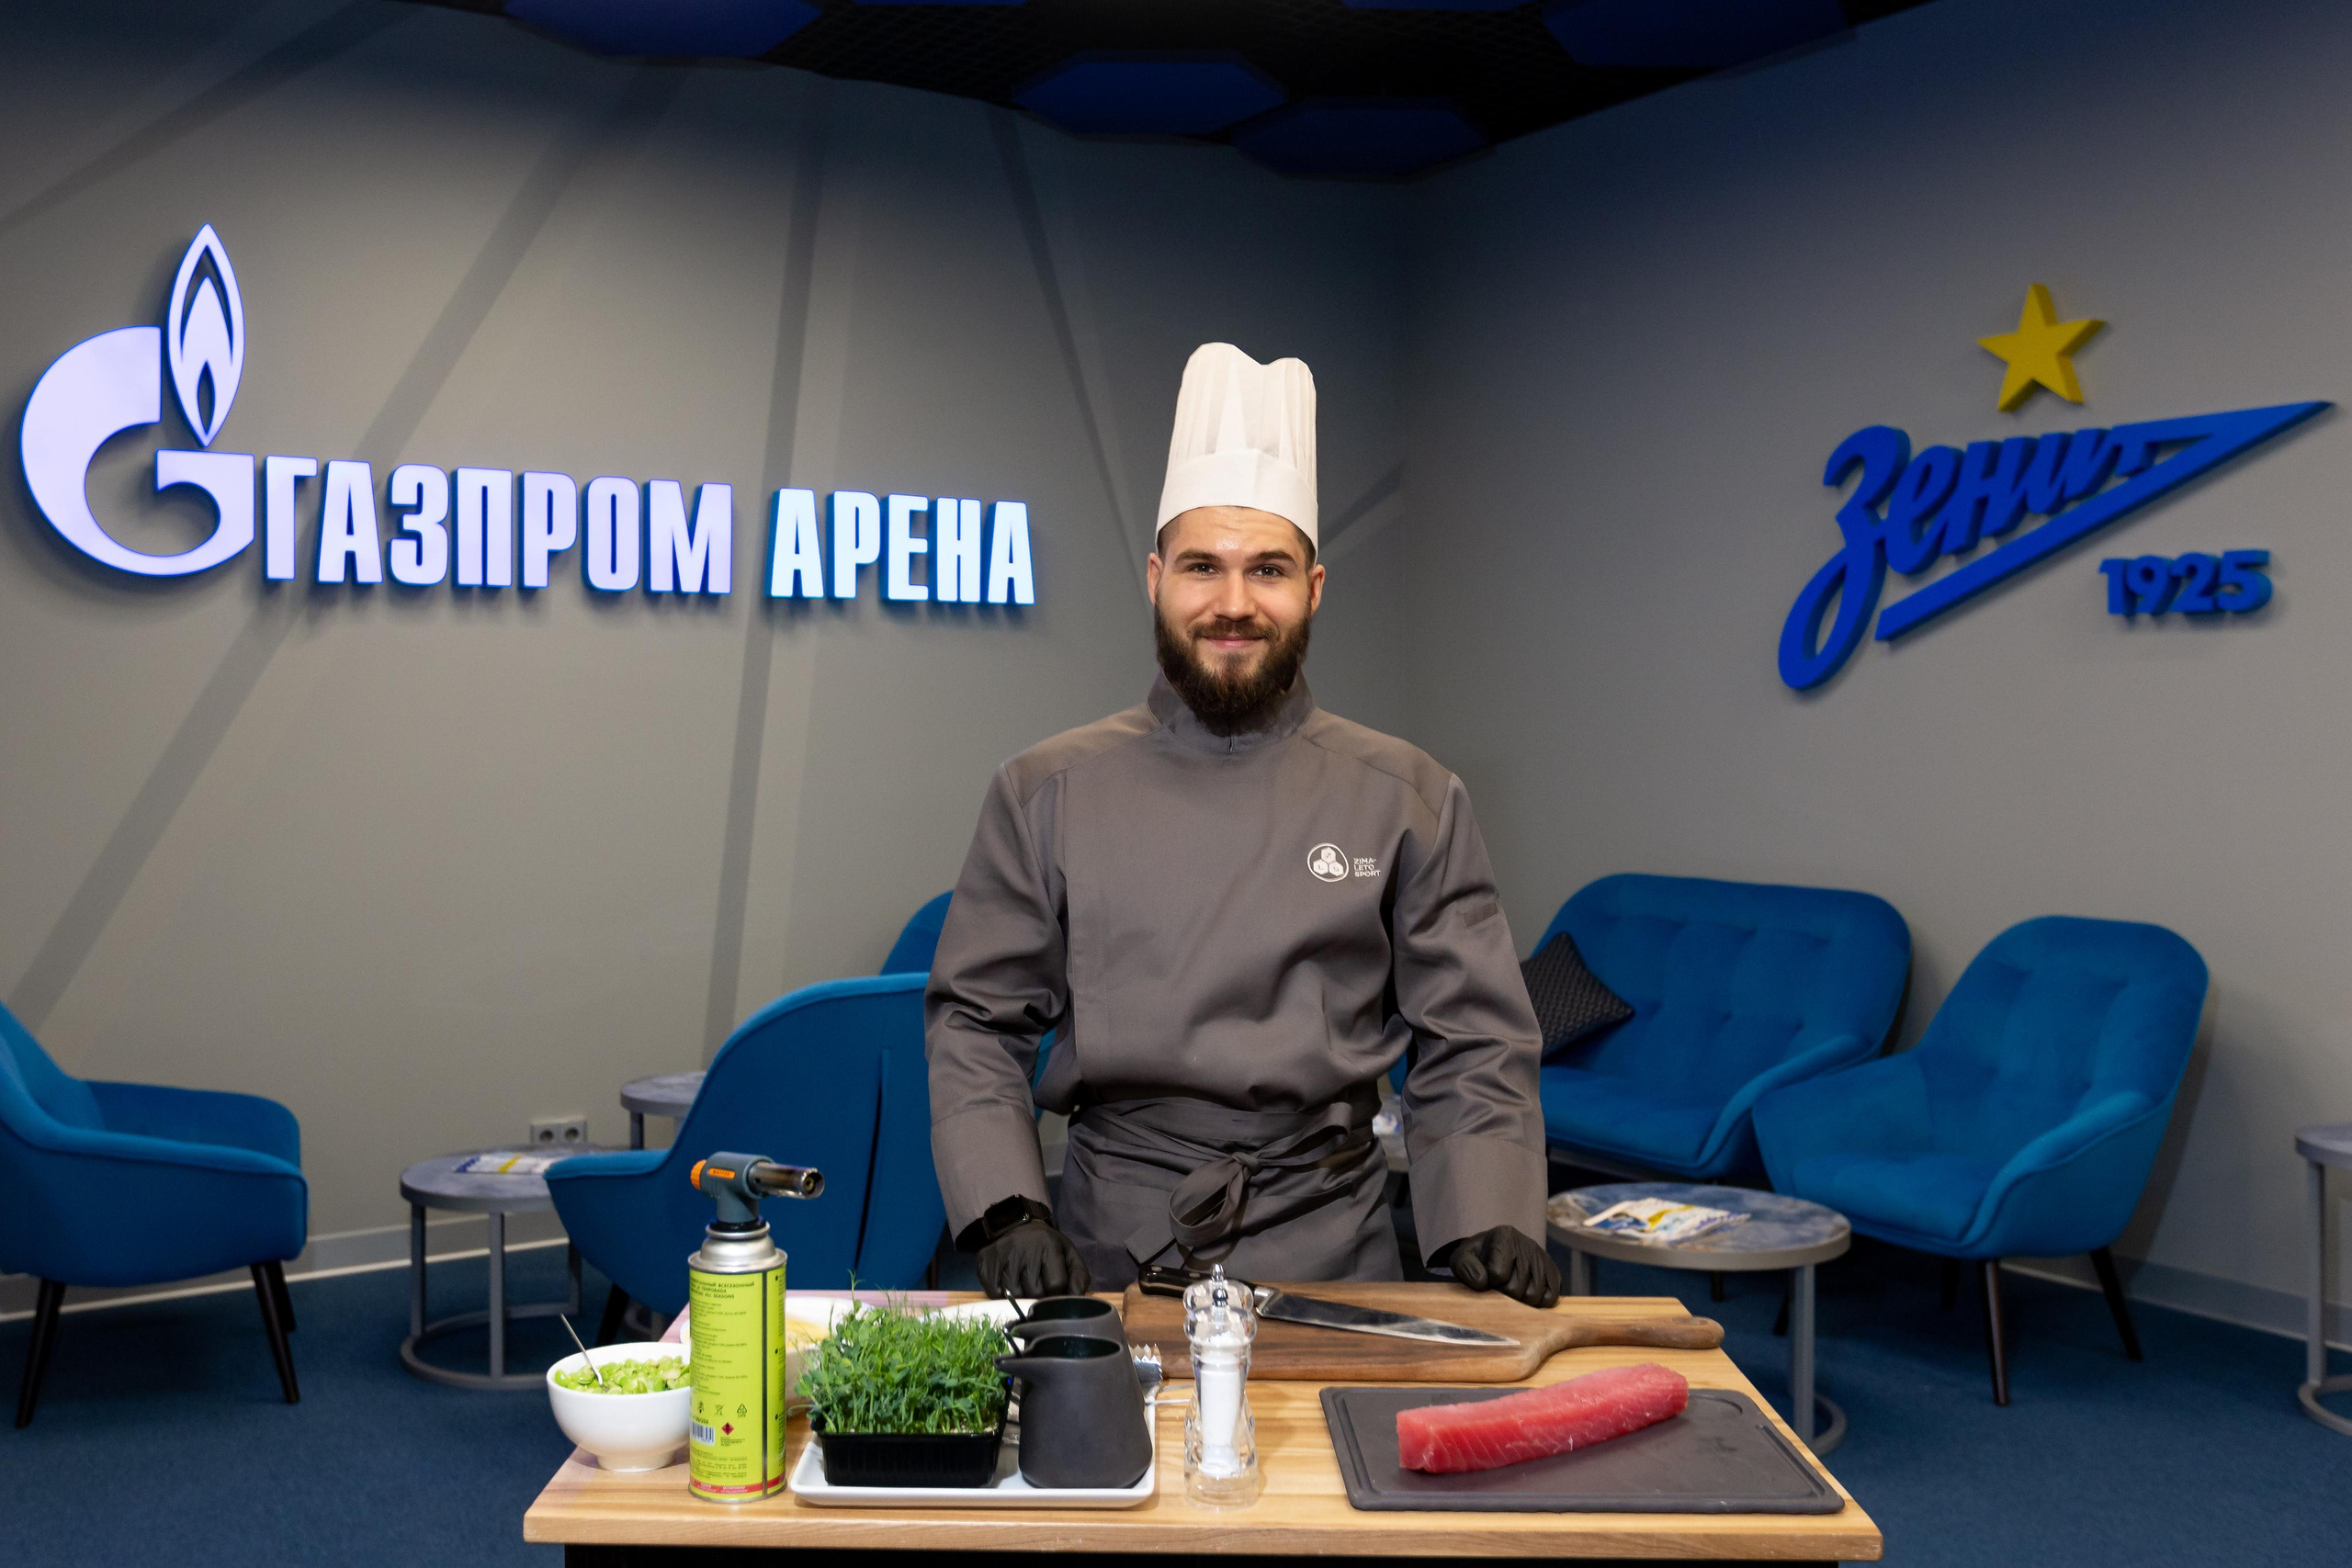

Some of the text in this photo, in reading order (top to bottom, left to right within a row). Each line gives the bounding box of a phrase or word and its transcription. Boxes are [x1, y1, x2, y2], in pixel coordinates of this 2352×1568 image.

[263, 455, 1035, 605] ГАЗПРОМ АРЕНА
[1778, 400, 2335, 690] Зенит
[2098, 549, 2273, 616] 1925
